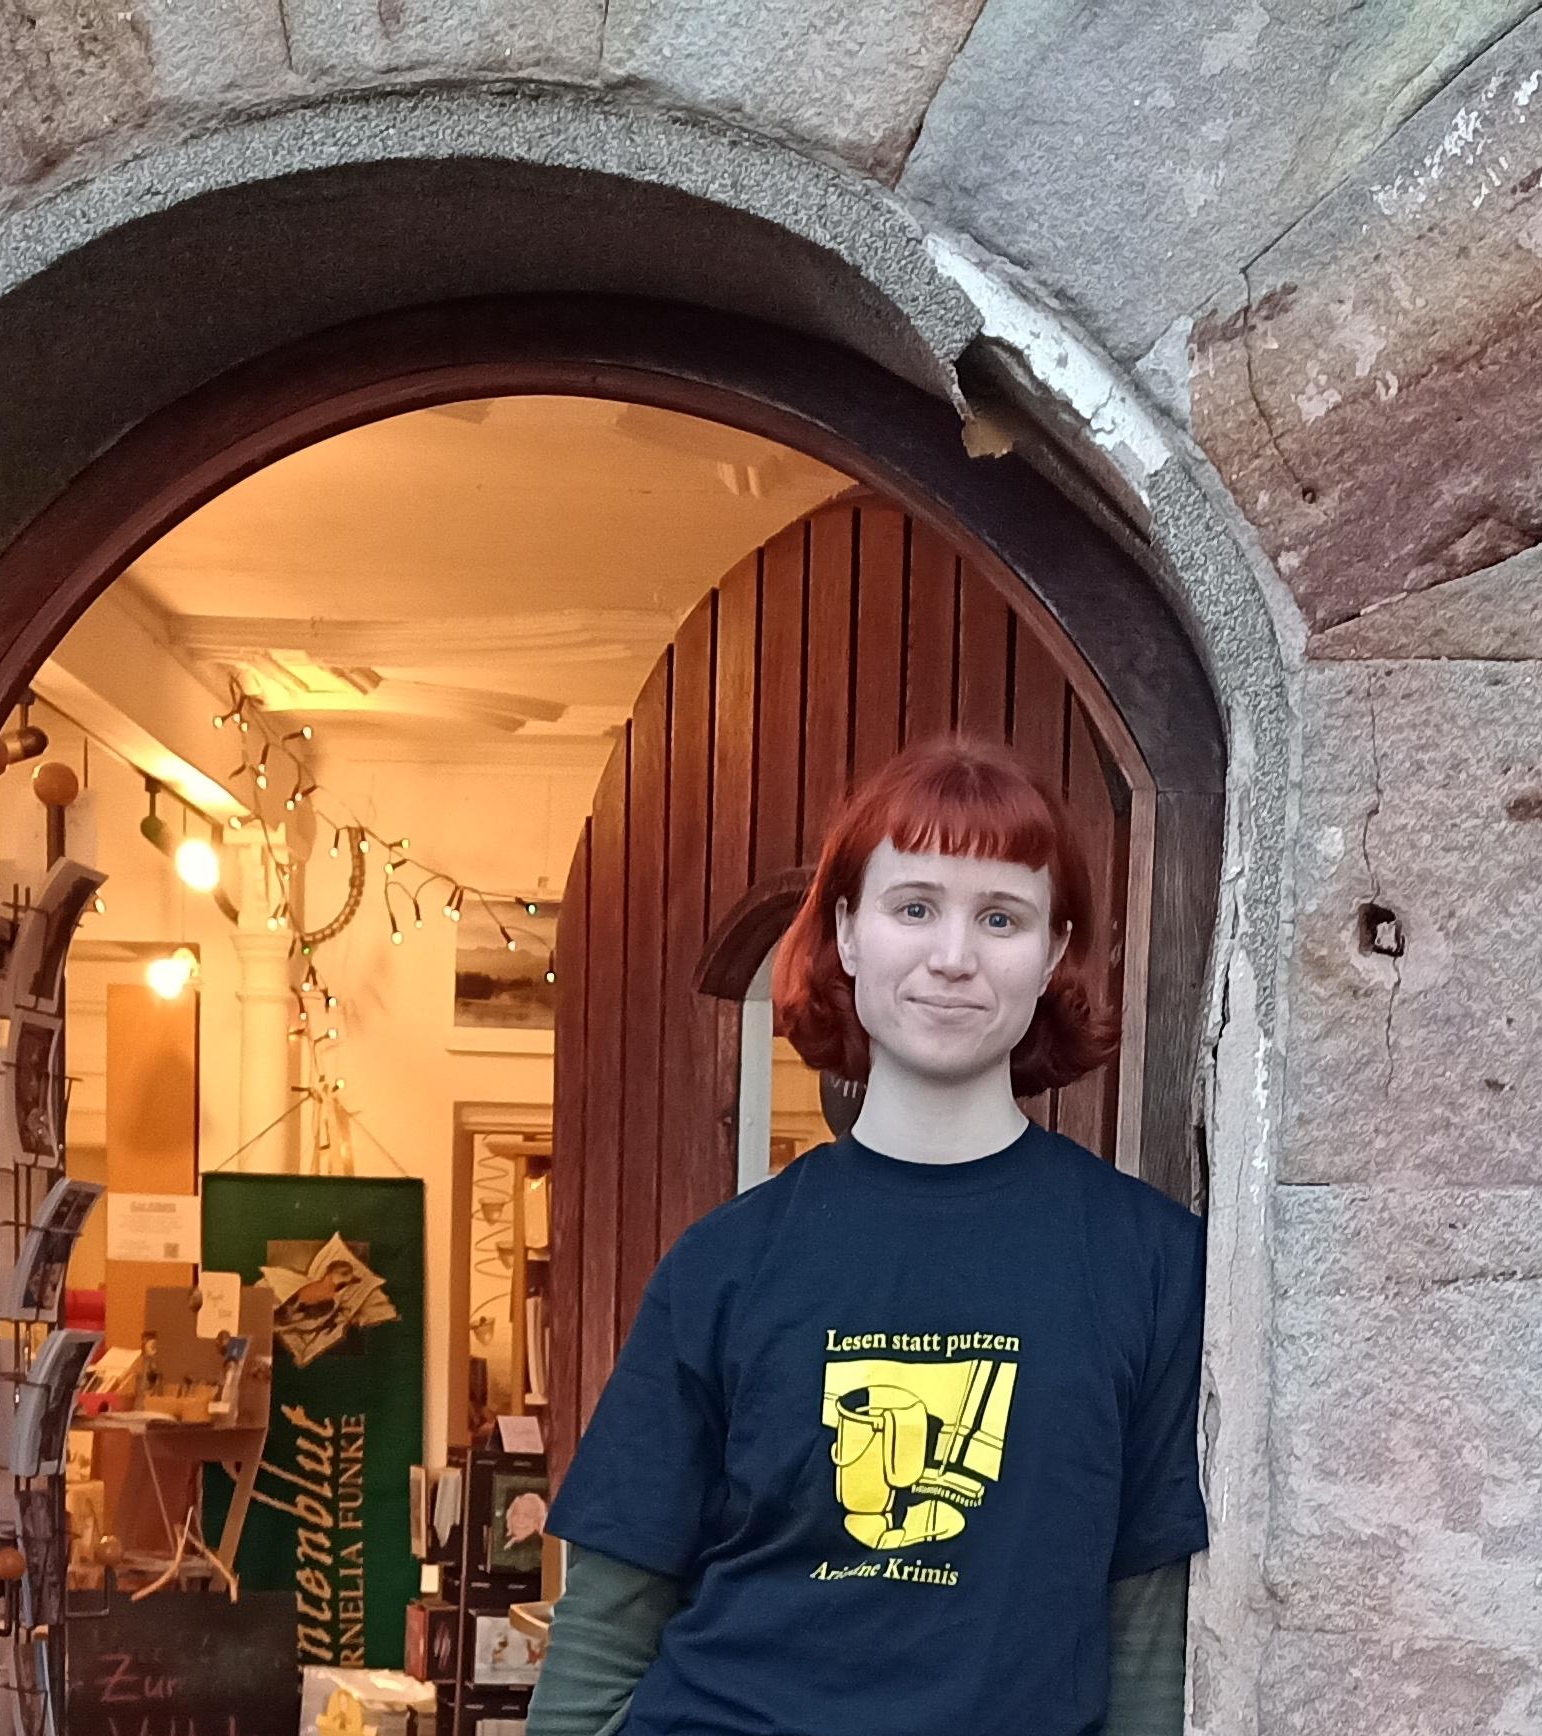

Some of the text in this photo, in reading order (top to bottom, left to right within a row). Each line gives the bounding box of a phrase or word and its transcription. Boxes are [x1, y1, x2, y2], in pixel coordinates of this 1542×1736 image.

[825, 1329, 1020, 1358] Lesen statt putzen
[252, 1404, 335, 1666] ntenblut
[338, 1413, 365, 1668] RNELIA FUNKE
[883, 1557, 960, 1587] Krimis
[95, 1653, 182, 1702] Zur
